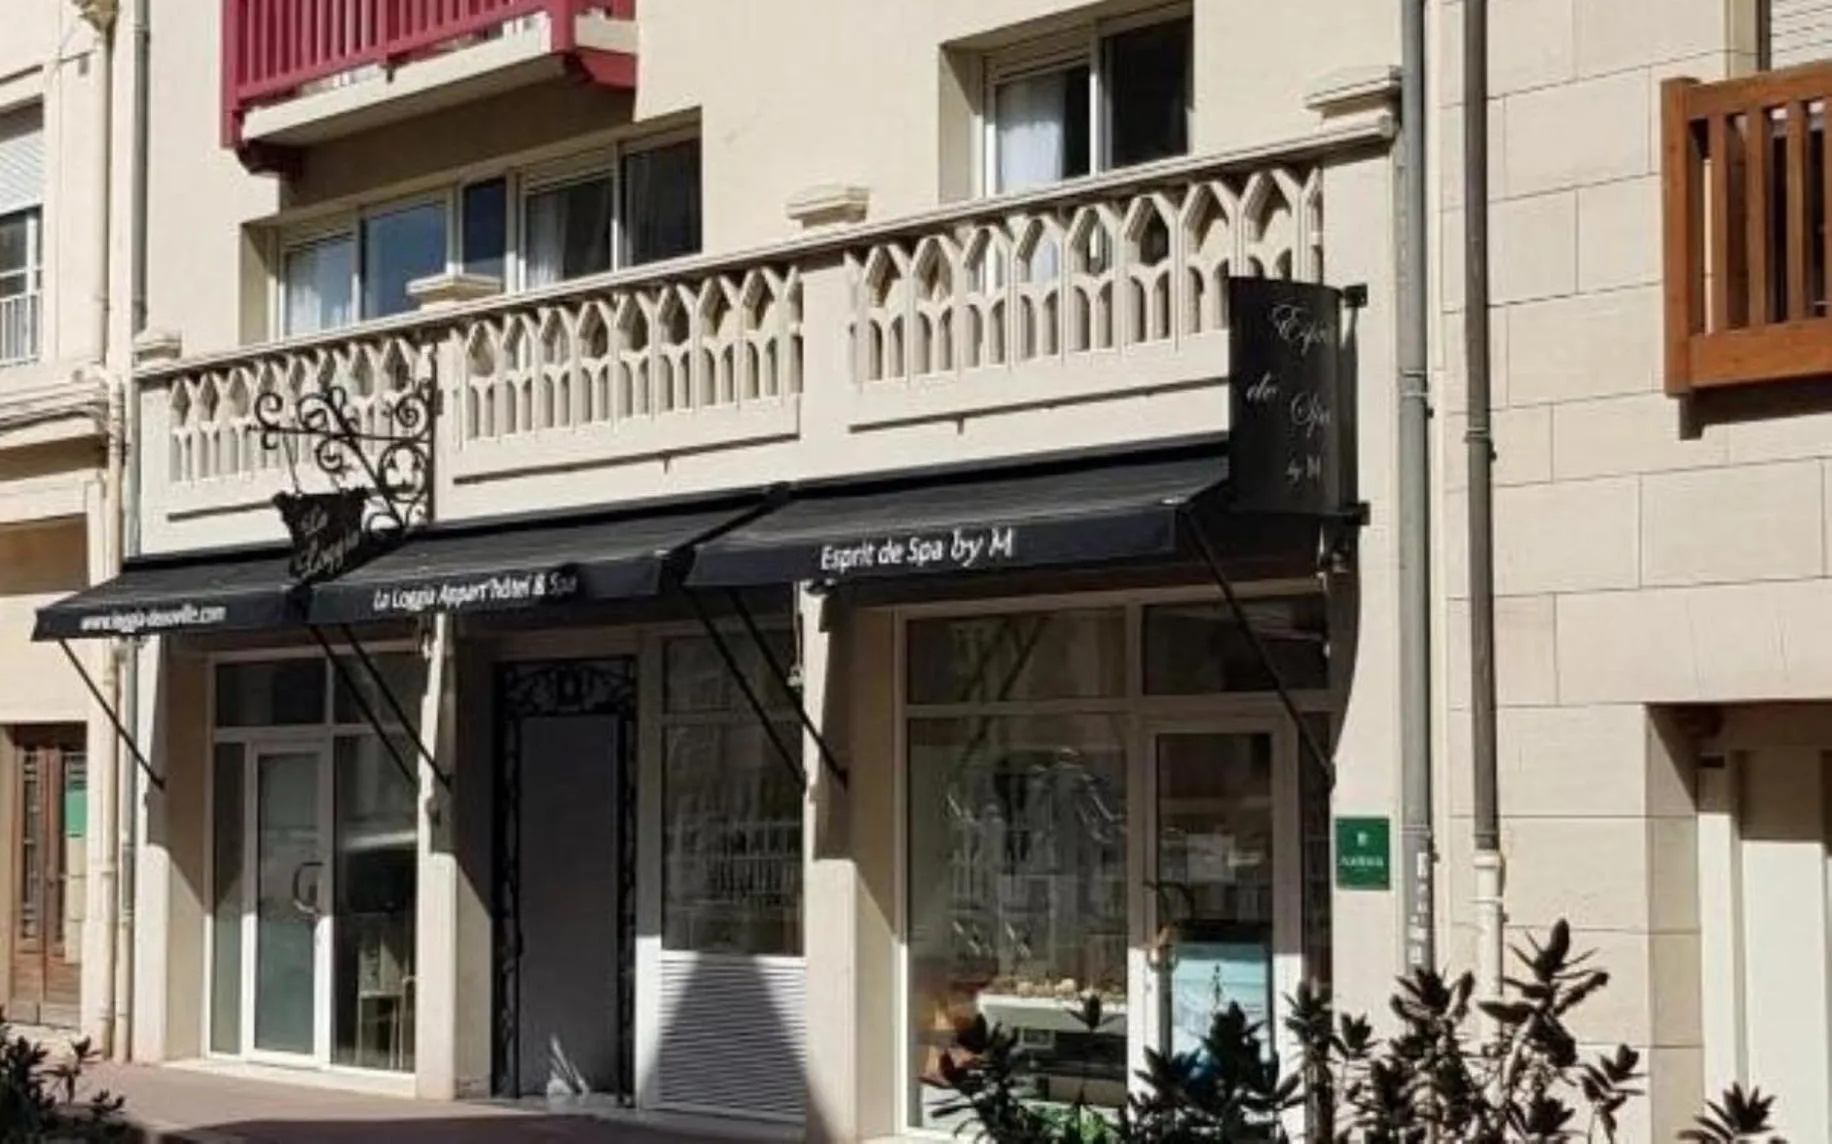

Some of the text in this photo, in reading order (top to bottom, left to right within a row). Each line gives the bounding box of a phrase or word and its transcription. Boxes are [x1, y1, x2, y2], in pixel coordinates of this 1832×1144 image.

[820, 527, 1014, 575] Esprit de Spa by M
[373, 587, 390, 612] La
